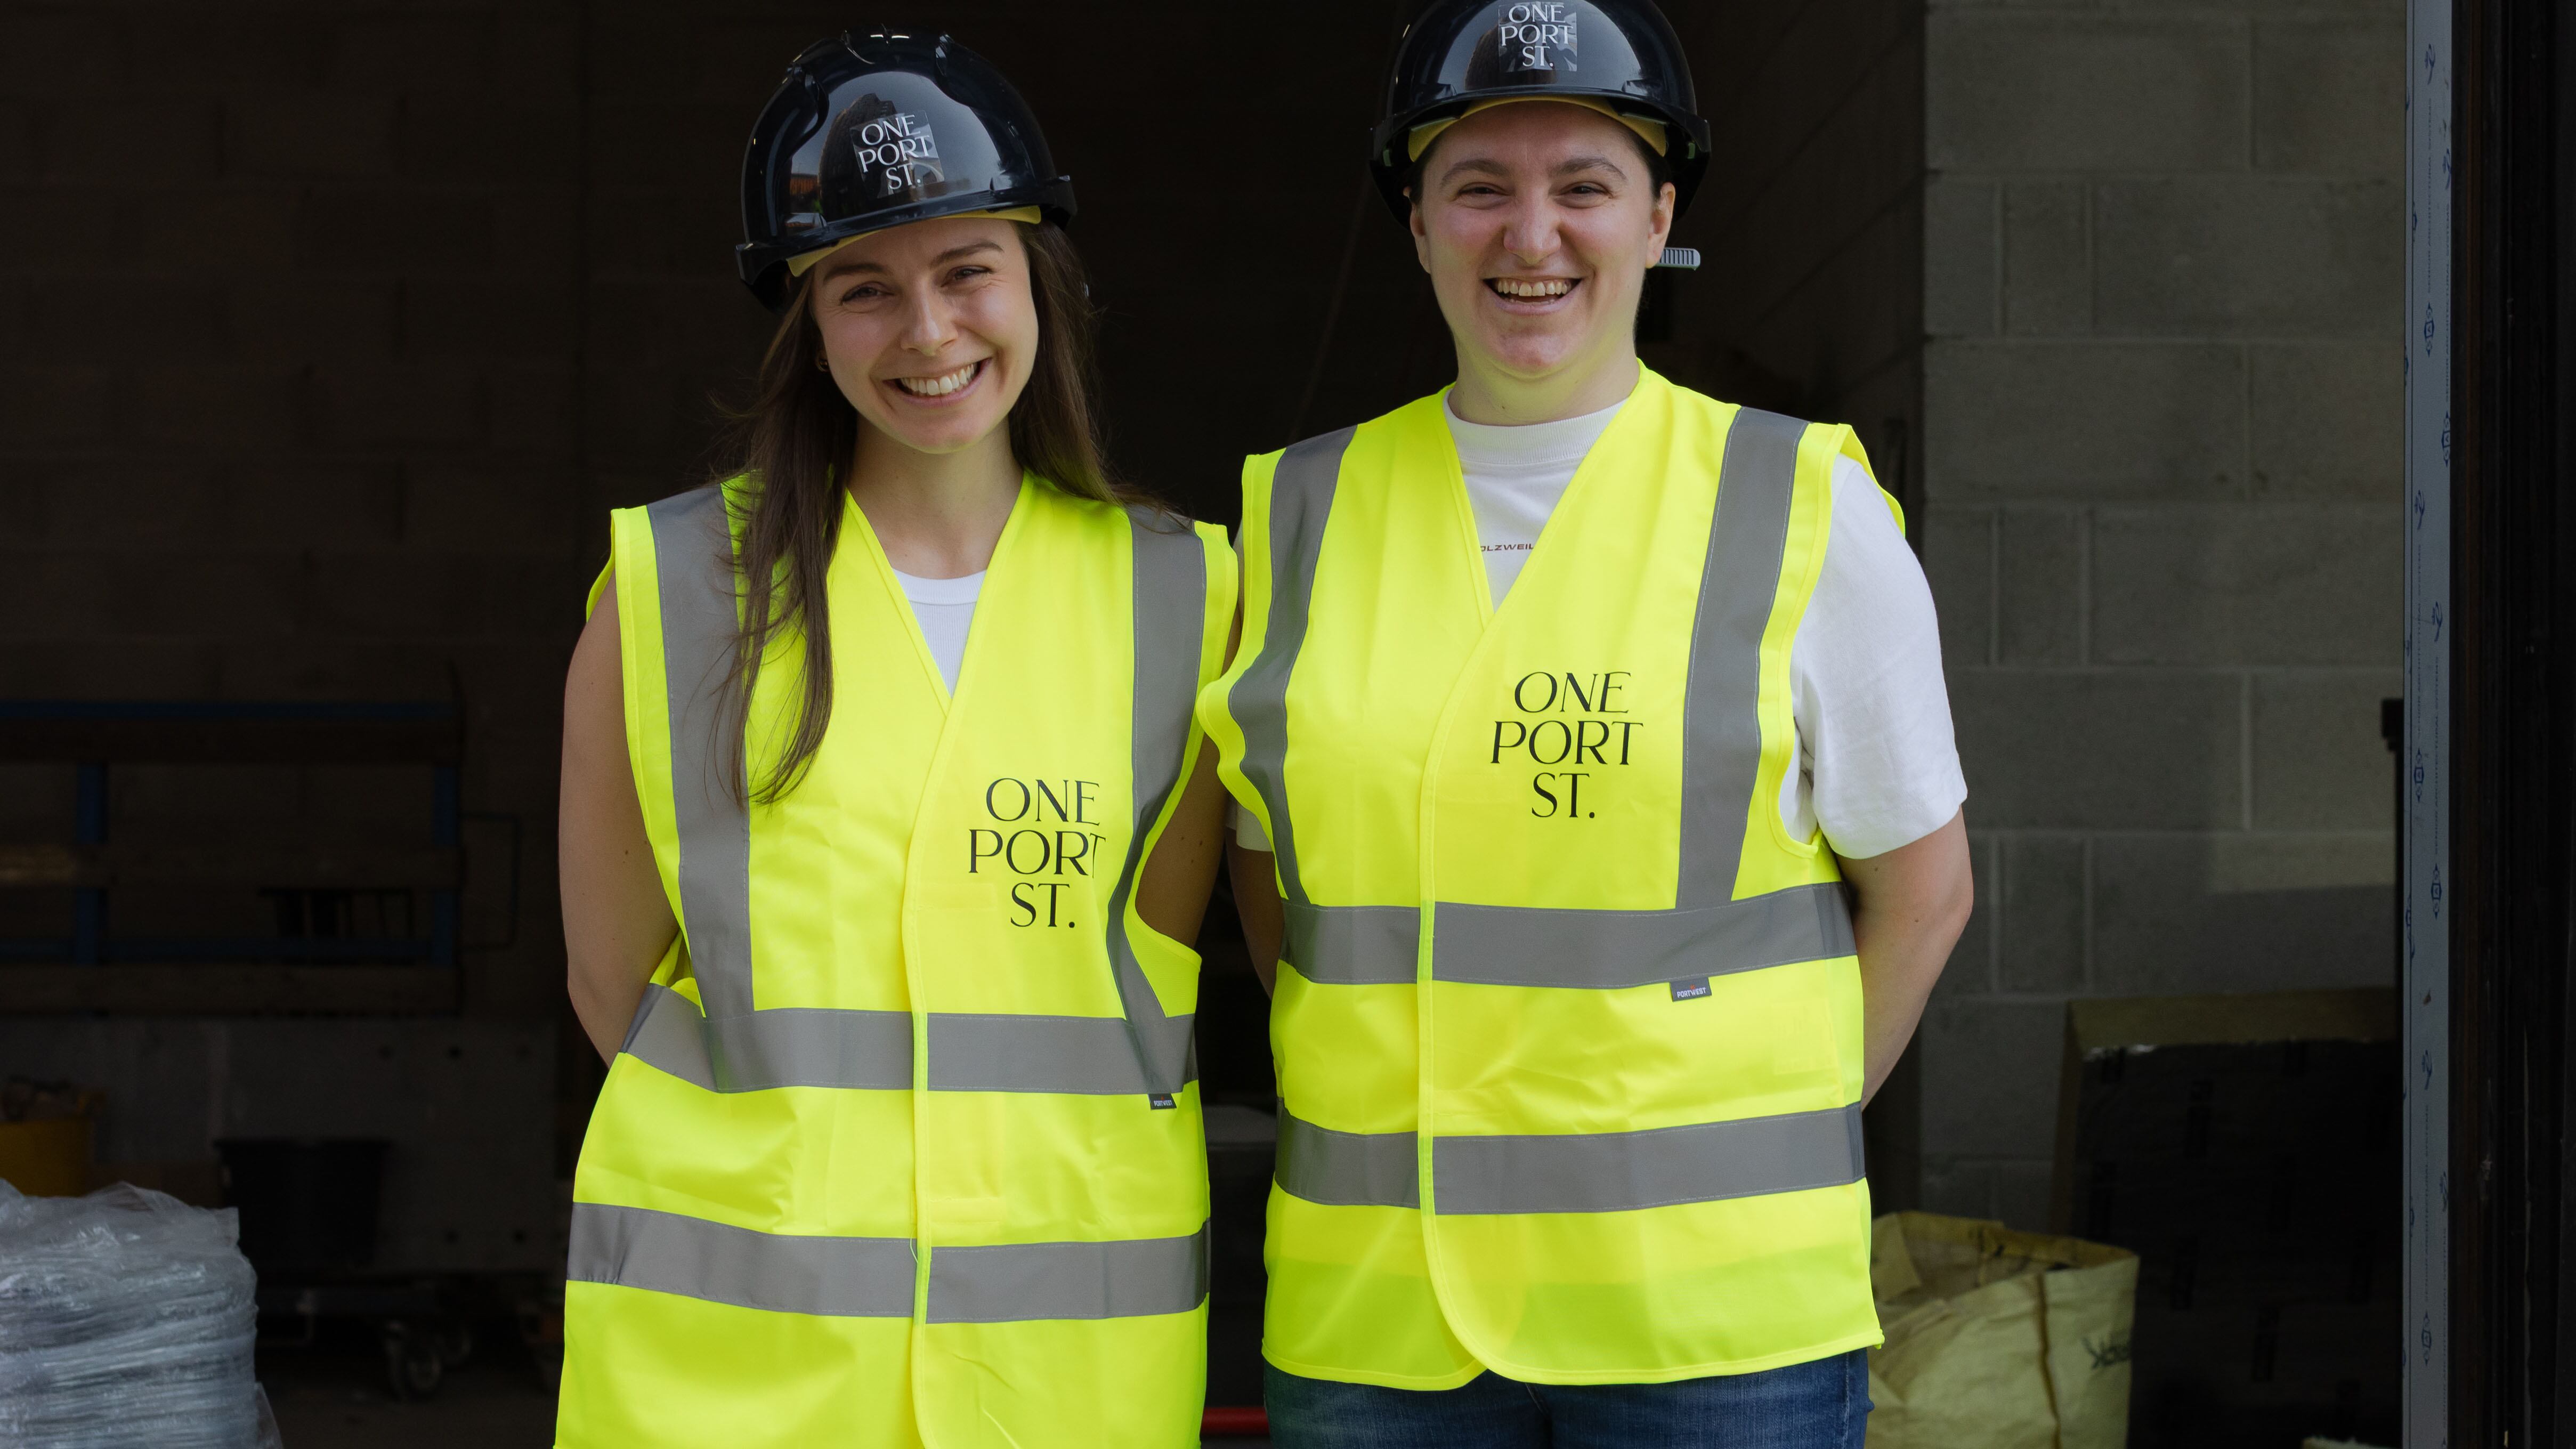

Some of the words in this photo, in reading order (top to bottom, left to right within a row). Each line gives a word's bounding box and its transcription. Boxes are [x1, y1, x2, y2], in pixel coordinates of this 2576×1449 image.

[1509, 4, 1566, 23] ONE
[1501, 25, 1574, 47] PORT
[1522, 46, 1553, 67] ST.
[862, 114, 921, 145] ONE
[858, 135, 930, 173] PORT
[885, 163, 921, 190] ST.
[1514, 671, 1632, 714] ONE
[1490, 719, 1644, 766] PORT
[986, 778, 1100, 827] ONE
[1531, 772, 1595, 819] ST.
[968, 828, 1107, 879] PORT
[1010, 882, 1075, 928] ST.
[1676, 987, 1707, 999] PORTWEST
